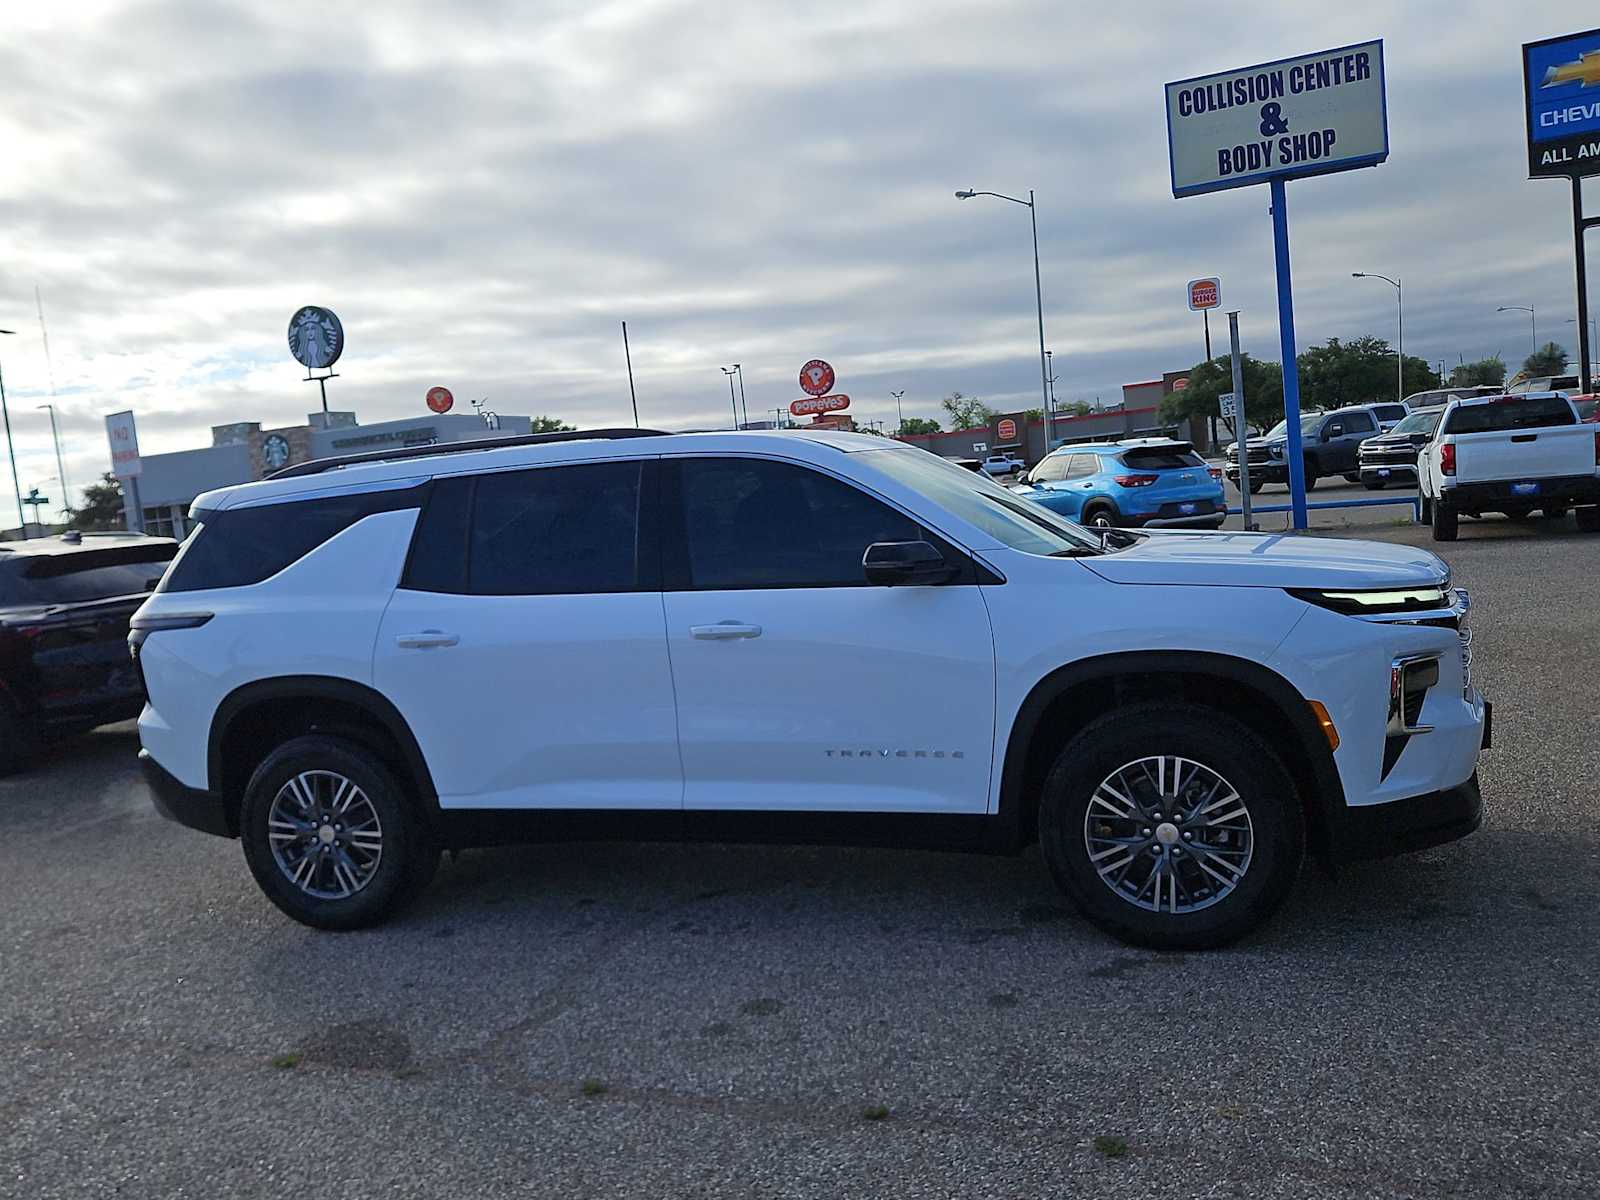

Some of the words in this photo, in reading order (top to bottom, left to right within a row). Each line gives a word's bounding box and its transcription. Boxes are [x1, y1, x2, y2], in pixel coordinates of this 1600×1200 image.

[1178, 70, 1285, 117] COLLISION
[1289, 52, 1370, 95] CENTER
[1260, 102, 1289, 137] &
[1218, 140, 1273, 176] BODY
[1278, 129, 1336, 165] SHOP
[1541, 147, 1573, 165] ALL
[1192, 287, 1217, 296] BURGER
[1192, 294, 1217, 304] KING
[824, 750, 964, 759] TRAVERSE
